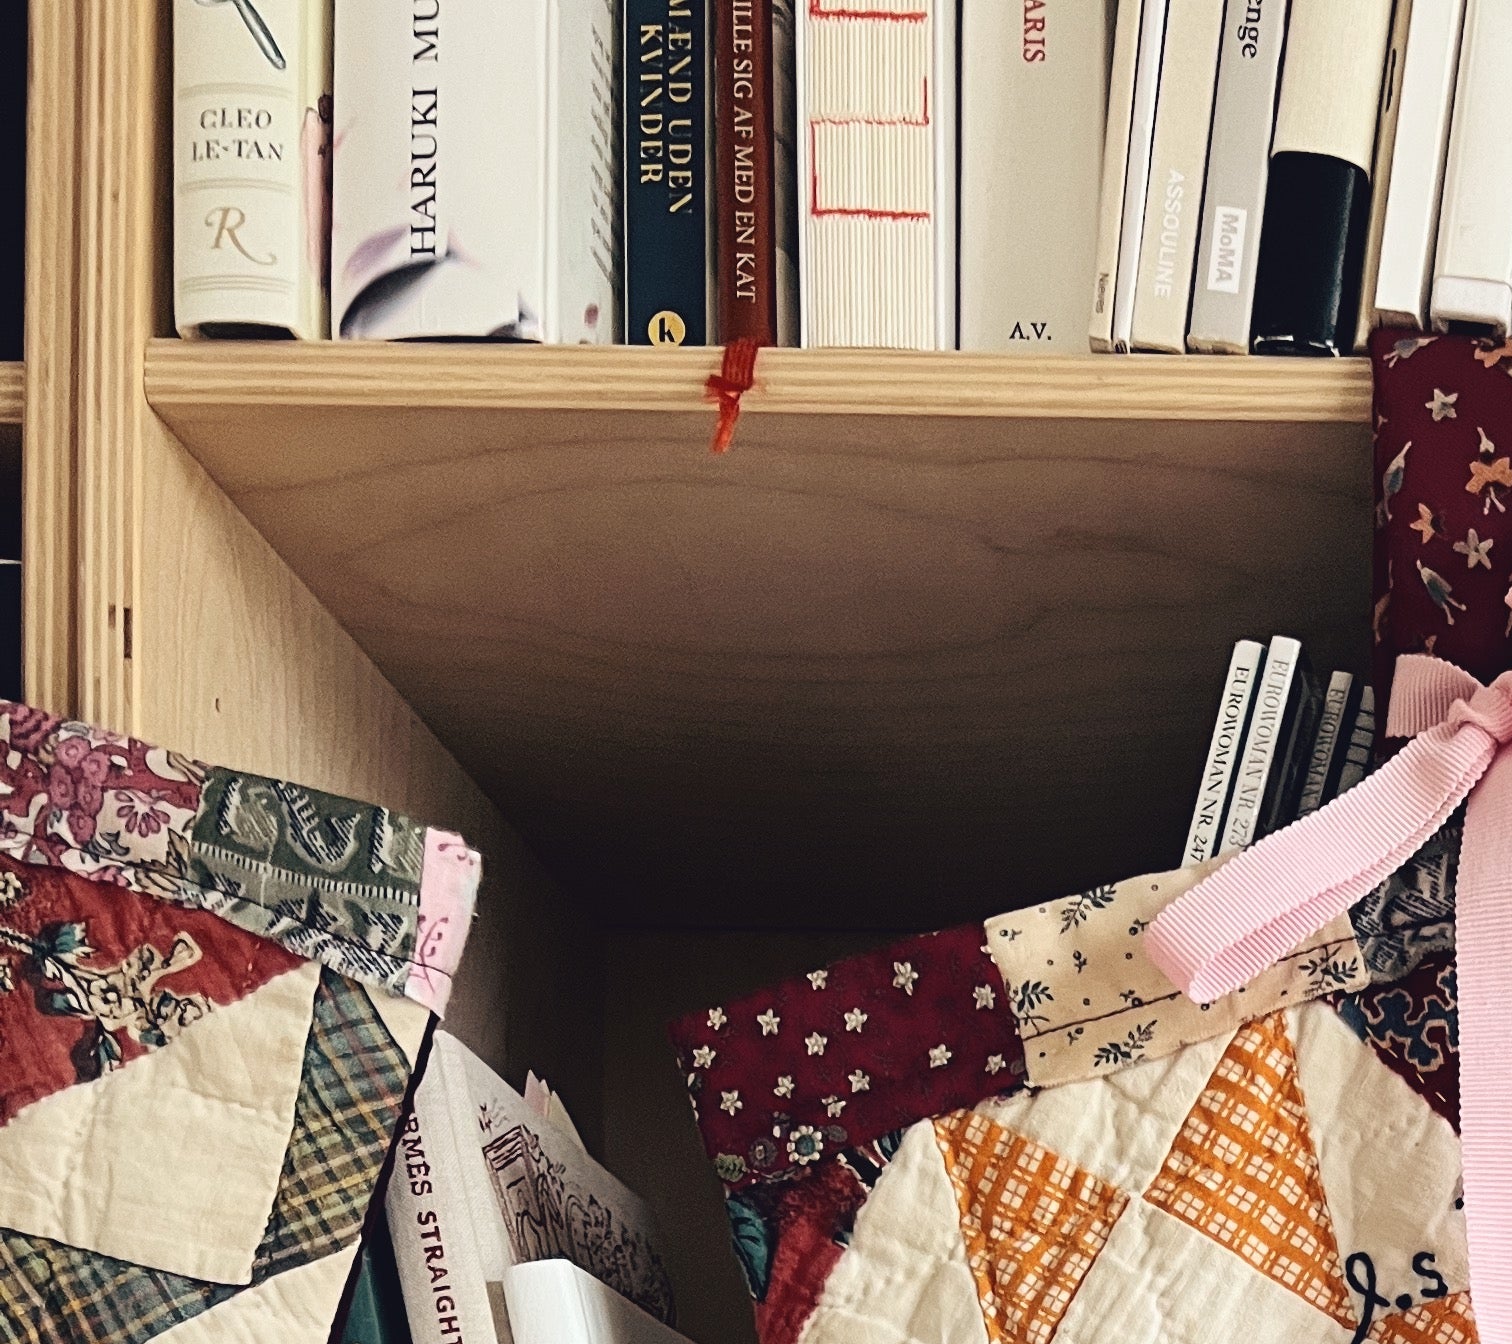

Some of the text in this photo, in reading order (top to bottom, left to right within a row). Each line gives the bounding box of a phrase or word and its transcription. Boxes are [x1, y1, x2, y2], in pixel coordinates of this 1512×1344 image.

[192, 139, 283, 161] LE-TAN
[200, 108, 272, 130] CLEO
[640, 24, 663, 184] KVINDER
[410, 88, 438, 258] HARUKI
[668, 119, 693, 215] UDEN
[733, 57, 756, 304] SIG AF MED EN KAT
[1154, 168, 1186, 300] ASSOULINE
[1215, 212, 1240, 284] MoMA
[1009, 322, 1052, 341] A.V.
[1206, 666, 1249, 791] EUROWOMAN
[1245, 658, 1289, 783] EUROWOMAN
